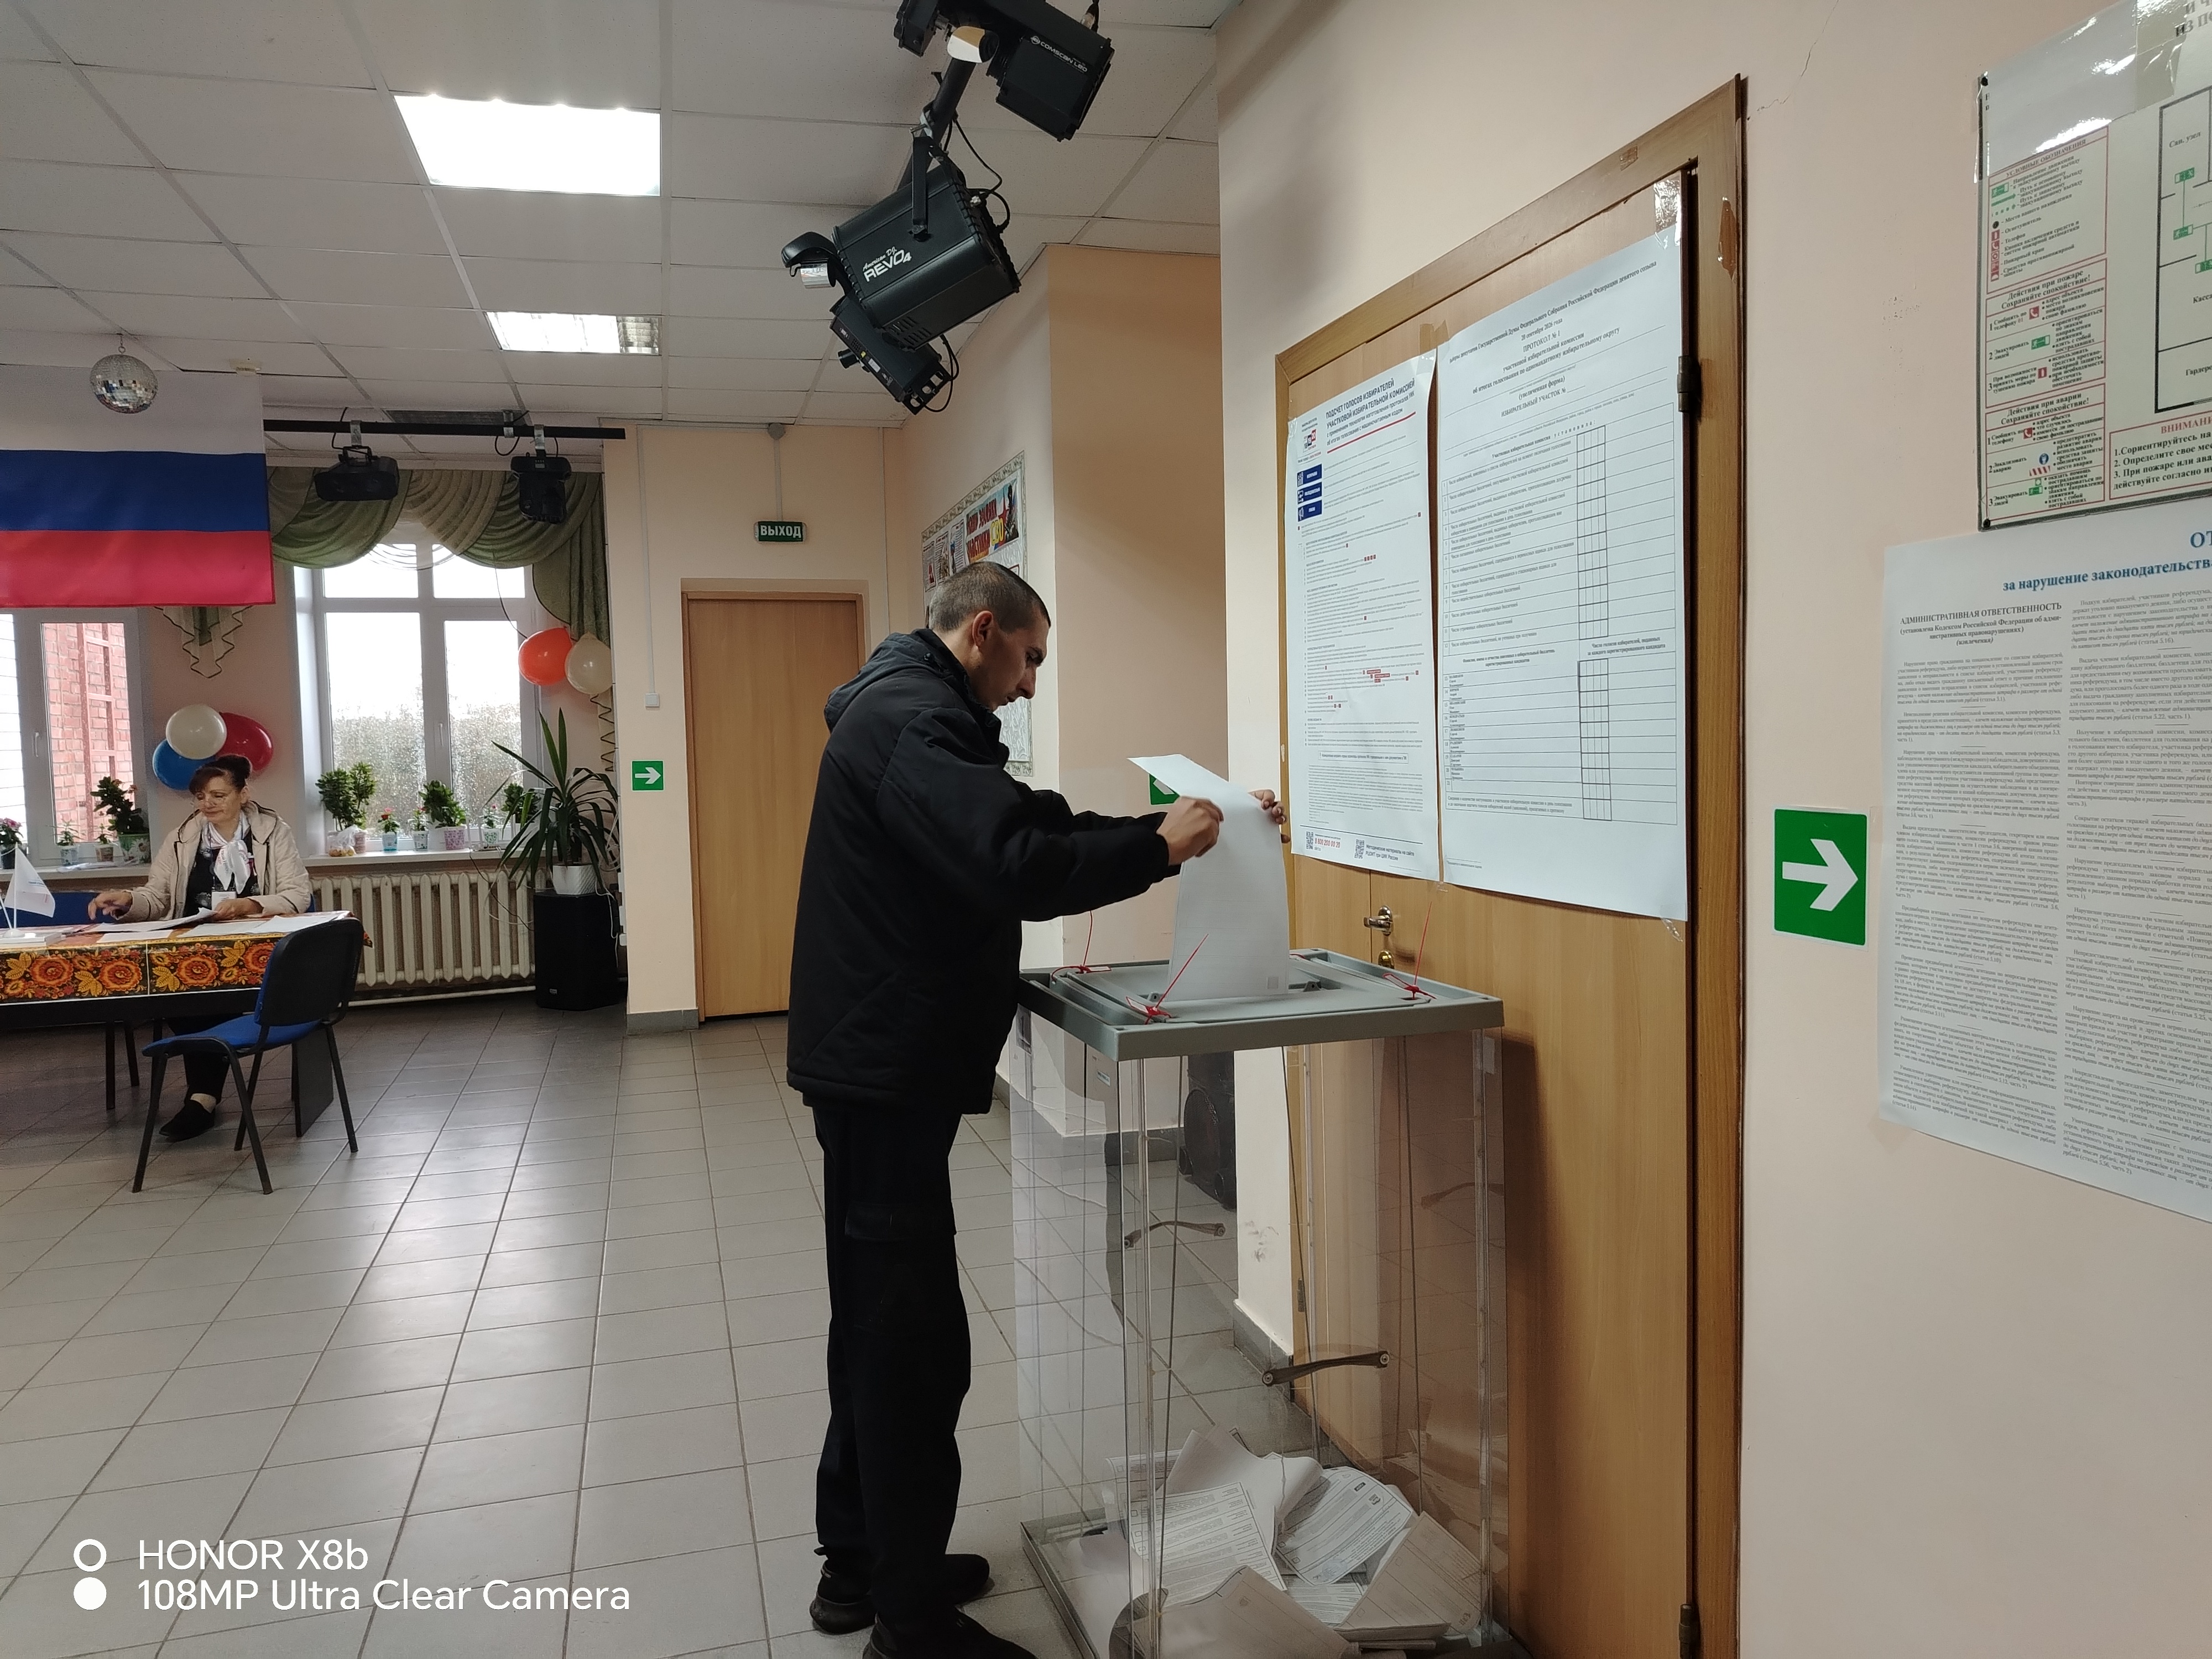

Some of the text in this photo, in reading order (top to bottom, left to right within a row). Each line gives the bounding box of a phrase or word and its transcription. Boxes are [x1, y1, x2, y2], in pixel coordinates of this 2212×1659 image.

[1074, 61, 1088, 72] LED
[2169, 132, 2201, 148] Сан. узел
[2006, 139, 2085, 178] УСЛОВНЫЕ ОБОЗНАЧЕНИЯ
[2013, 156, 2074, 184] Направление движения
[2005, 194, 2072, 223] Место вашего нахождения
[2005, 217, 2041, 233] Огнетушитель
[2005, 233, 2025, 243] Телефон
[864, 249, 912, 282] REVO4
[2002, 244, 2074, 275] Средства противопожарной
[2004, 252, 2031, 265] Пожарный
[2001, 274, 2090, 309] Сохраняйте спокойствие!
[2007, 271, 2083, 301] Действия при пожаре
[1460, 344, 1479, 357] депутатов
[1478, 330, 1508, 349] Государственной
[1509, 325, 1520, 336] Думы
[1519, 314, 1547, 330] Федерального
[1547, 304, 1567, 316] Собрания
[1568, 290, 1593, 306] Российской
[1593, 279, 1618, 294] Федерации
[1619, 270, 1639, 283] девятого
[1640, 262, 1656, 273] созыва
[1994, 315, 2019, 325] Сообщить
[1994, 321, 2016, 330] телефону
[1503, 333, 1584, 373] участковой избирательной комиссии
[1524, 335, 1550, 352] ПРОТОКОЛ
[1995, 342, 2029, 354] Эвакуировать
[1479, 383, 1492, 392] итогах
[1493, 371, 1519, 385] голосования
[1526, 352, 1561, 372] одномандатному
[1563, 335, 1602, 356] избирательному
[1603, 327, 1620, 338] округу
[1326, 379, 1394, 419] ПОДСЧЕТ ГОЛОСОВ ИЗБИРАТЕЛЕЙ
[1519, 384, 1547, 400] (увеличенная
[1548, 375, 1565, 388] форма)
[1327, 410, 1352, 429] УЧАСТКОВОЙ
[1353, 392, 1388, 416] ИЗБИРАТЕЛЬНОЙ
[1390, 378, 1415, 399] КОМИССИЕЙ
[1501, 397, 1537, 417] ИЗБИРАТЕЛЬНЫЙ
[1539, 389, 1560, 402] УЧАСТОК
[2001, 398, 2089, 425] Сохраняйте спокойствие!
[2007, 404, 2039, 417] Действия
[2056, 393, 2081, 404] аварии
[2123, 451, 2173, 465] Определите
[2124, 468, 2140, 477] При
[2143, 462, 2174, 473] пожаре
[2114, 476, 2160, 490] действуйте
[2163, 469, 2201, 481] согласно
[760, 525, 801, 538] ВЫХОД
[990, 518, 1004, 546] СВО
[2003, 560, 2212, 591] за нарушение законодательств
[1902, 603, 2062, 624] АДМИНИСТРАТИВНАЯ ОТВЕТСТВЕННОСТЬ
[1963, 620, 1996, 628] Российской
[1957, 637, 1994, 646] (извлечения)
[1968, 627, 2024, 637] правонарушениях)
